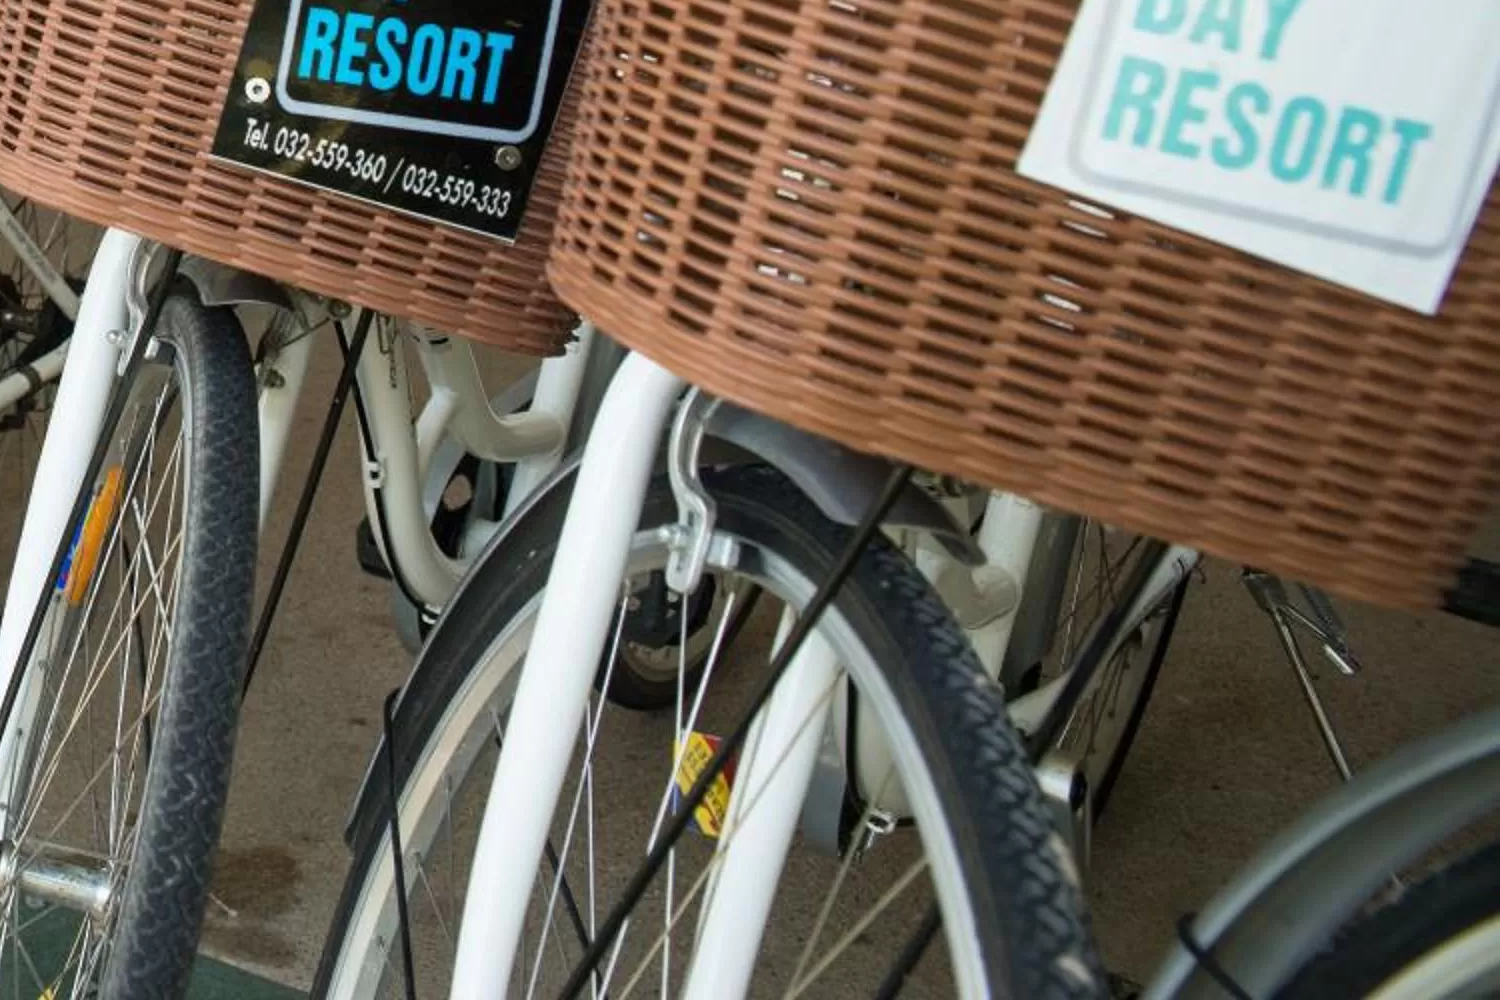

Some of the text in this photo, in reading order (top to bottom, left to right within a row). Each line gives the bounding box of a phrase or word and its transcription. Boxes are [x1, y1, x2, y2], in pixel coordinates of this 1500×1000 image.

[298, 8, 515, 103] RESORT
[243, 118, 269, 150] Tel.
[273, 130, 386, 184] 032-559-360
[402, 166, 511, 218] 032-559-333
[1101, 55, 1433, 206] RESORT
